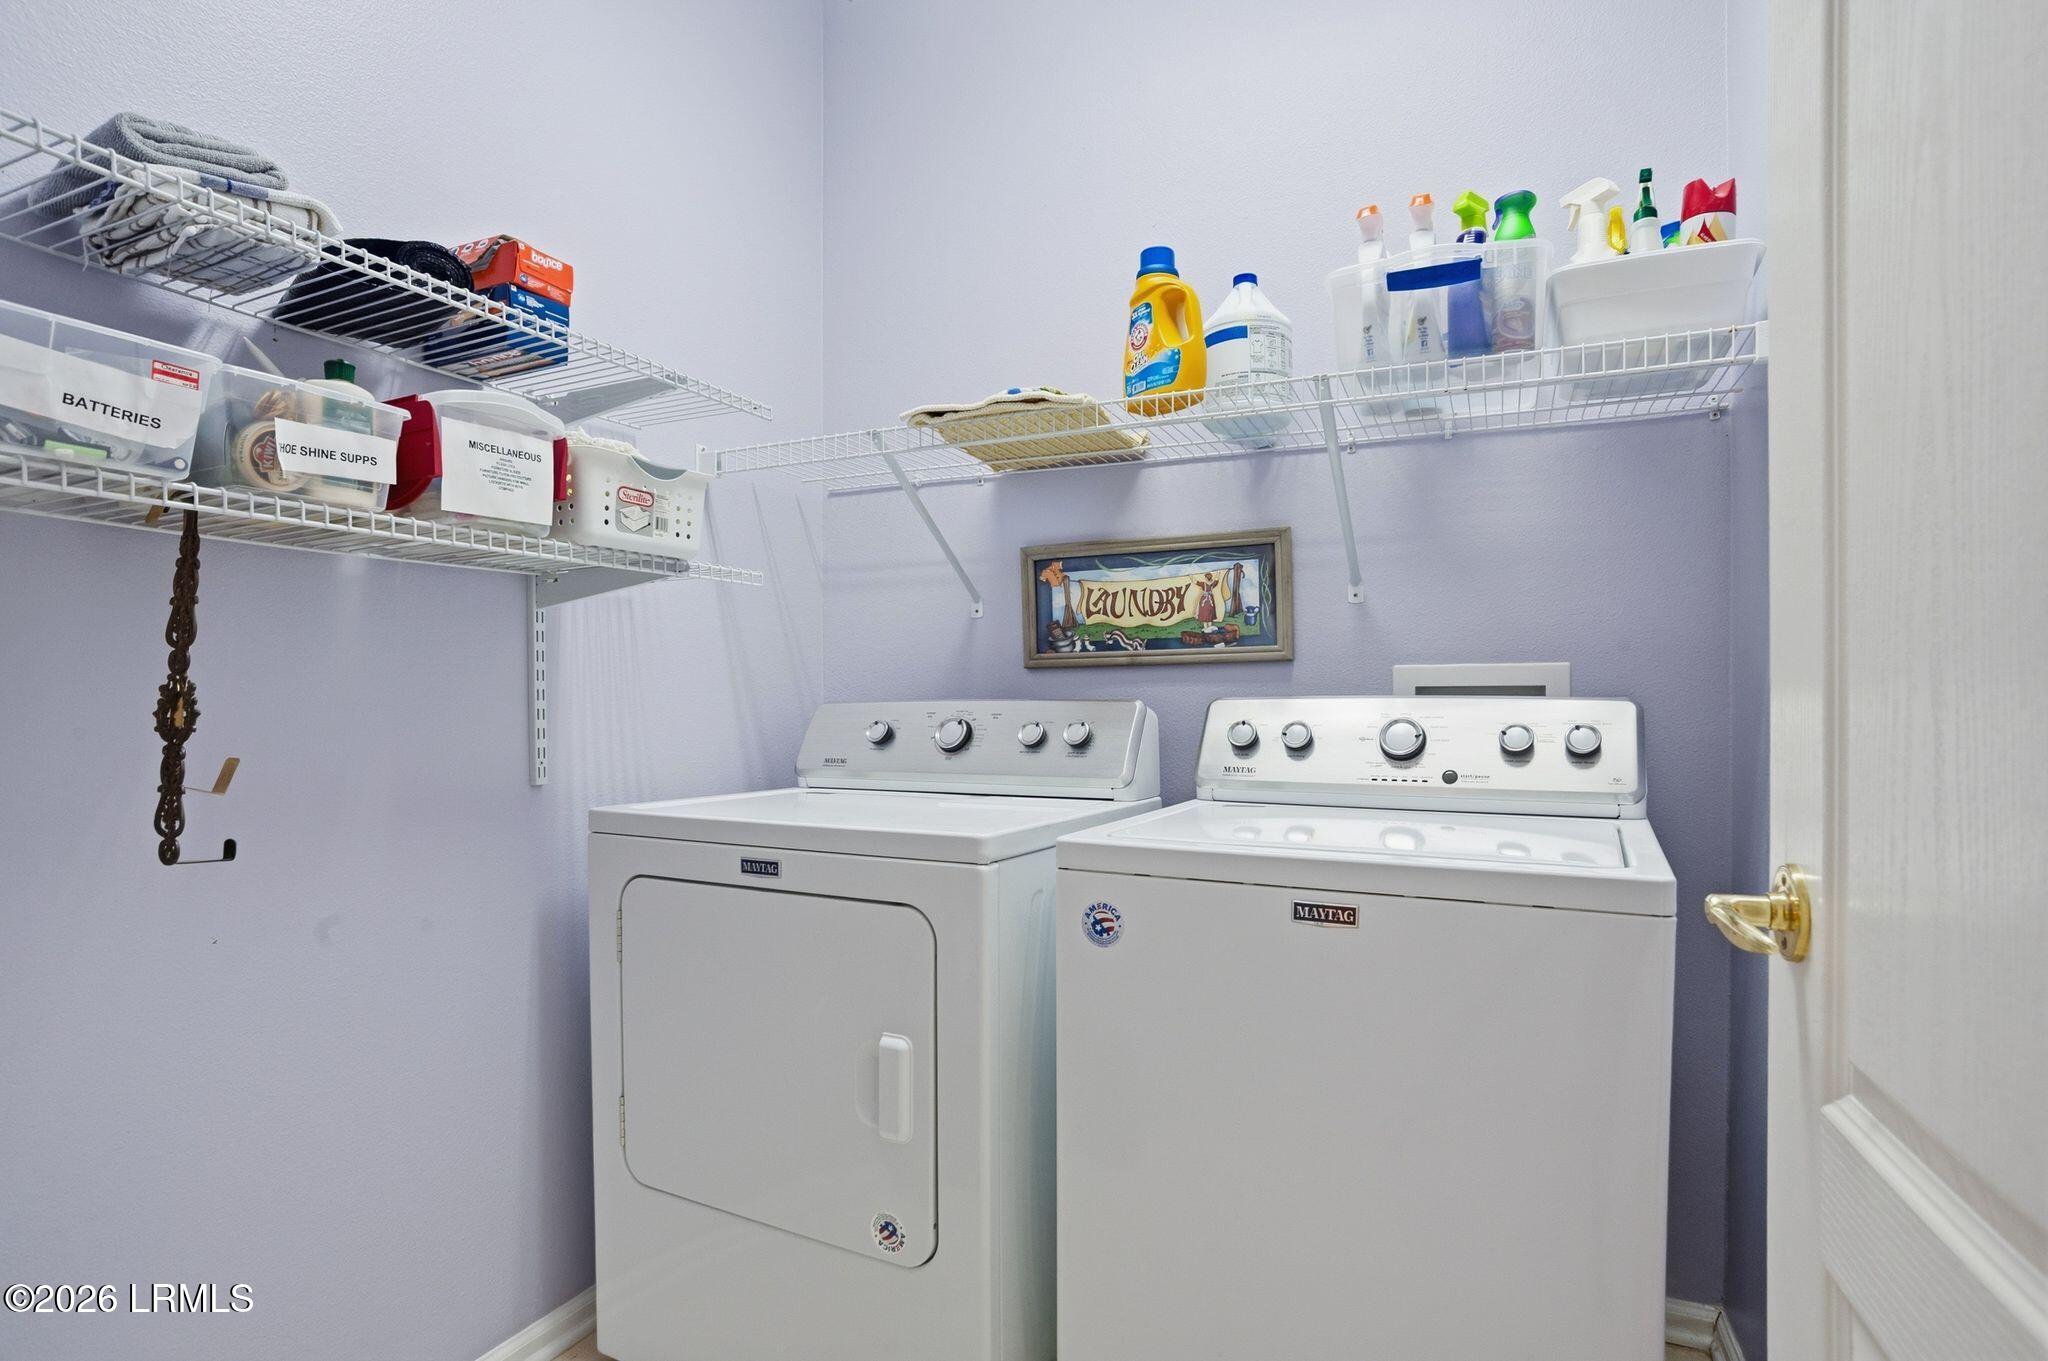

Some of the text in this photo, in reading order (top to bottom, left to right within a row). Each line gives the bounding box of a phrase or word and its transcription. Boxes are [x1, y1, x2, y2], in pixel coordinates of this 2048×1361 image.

[531, 250, 563, 272] bounce
[62, 392, 162, 430] BATTERIES
[279, 442, 378, 467] HOE SHINE SUPPS
[468, 439, 542, 463] MISCELLANEOUS
[622, 489, 651, 504] Sterilite
[1085, 582, 1192, 622] LAUNDRY
[1222, 766, 1257, 774] MAYTAG
[742, 861, 778, 874] MAYTAG
[1084, 902, 1121, 922] AMERICA
[1296, 905, 1355, 922] MAYTAG
[878, 1232, 906, 1253] AMERICA
